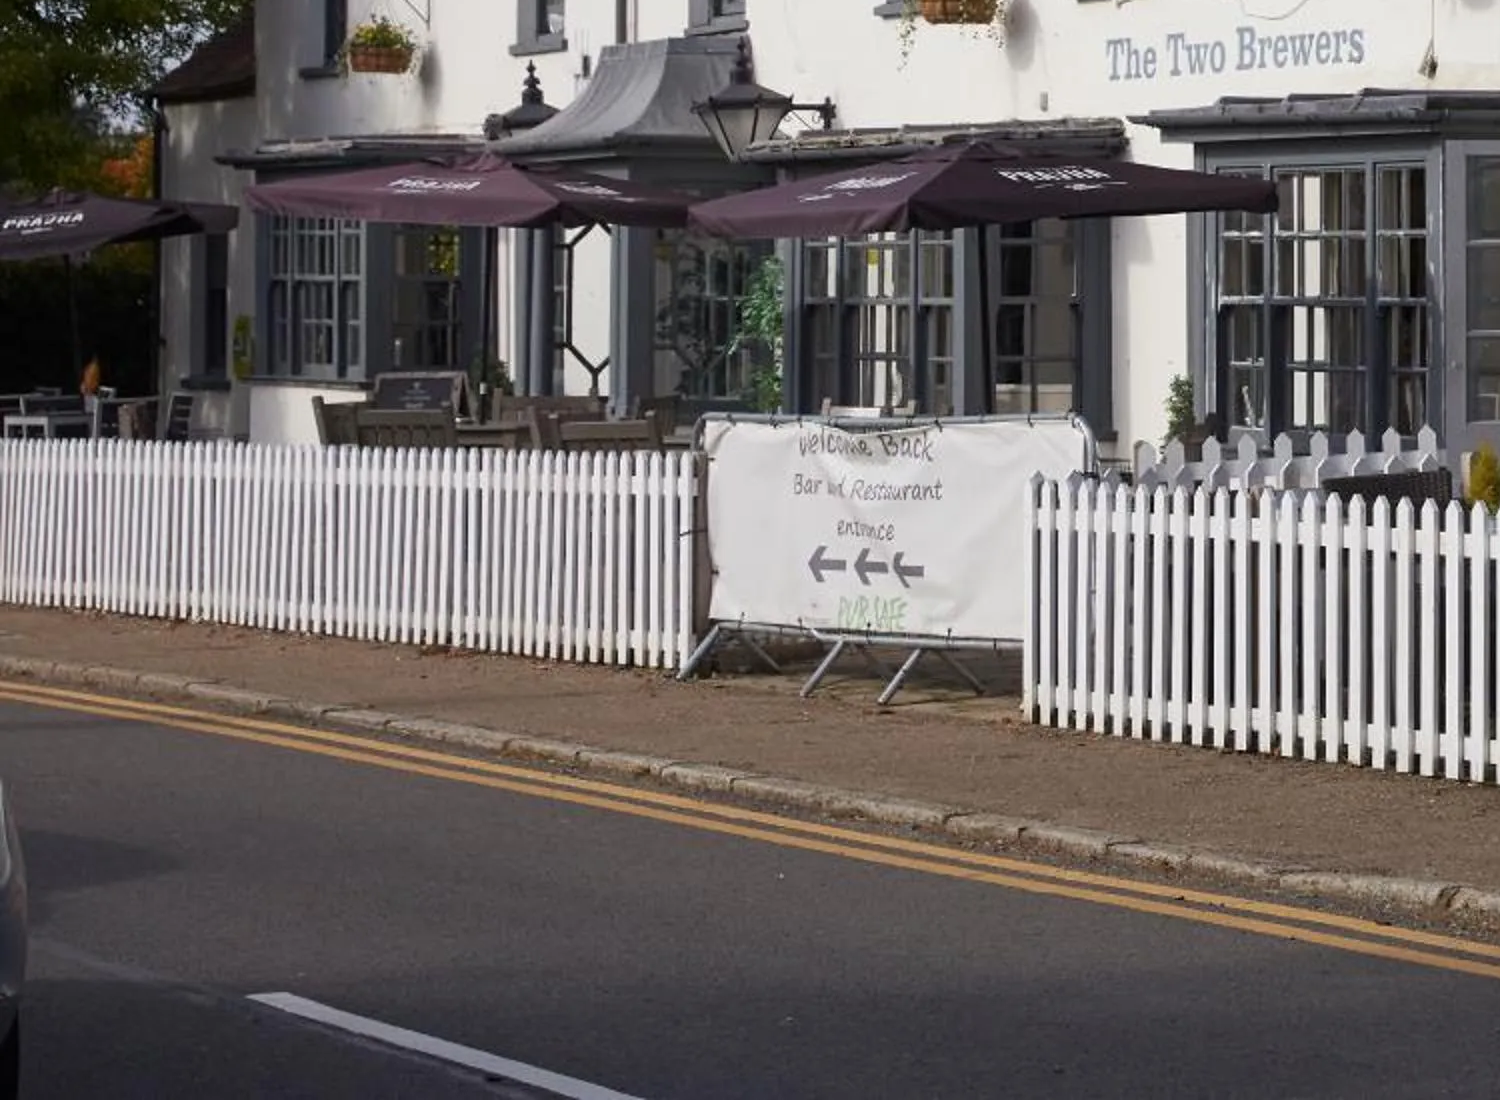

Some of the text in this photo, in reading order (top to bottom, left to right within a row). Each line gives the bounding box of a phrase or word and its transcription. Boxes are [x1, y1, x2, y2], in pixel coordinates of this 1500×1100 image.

[1106, 26, 1365, 81] The Two Brewers
[878, 431, 934, 462] Back
[793, 473, 822, 496] Bar
[850, 477, 943, 501] Restaurant
